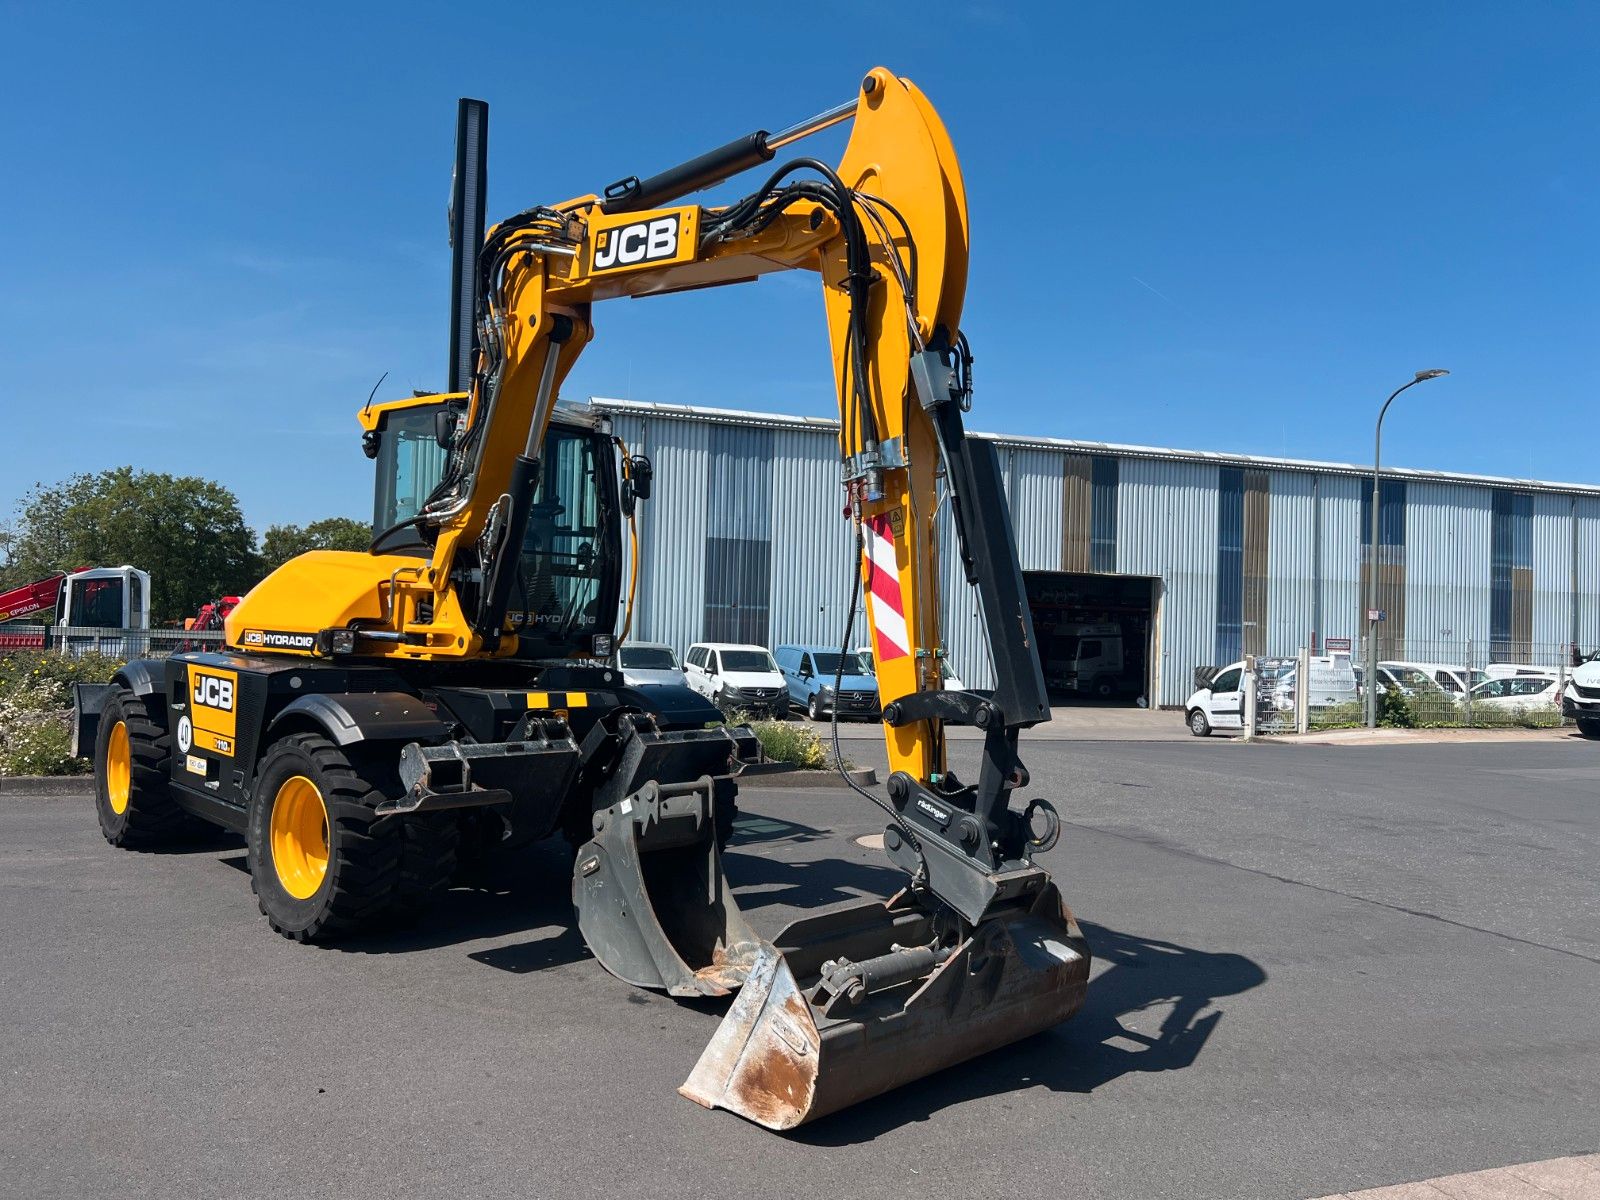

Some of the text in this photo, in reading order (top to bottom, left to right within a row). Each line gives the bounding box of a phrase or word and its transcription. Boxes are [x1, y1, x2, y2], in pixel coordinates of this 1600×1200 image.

[595, 218, 677, 267] JCB
[10, 603, 40, 616] EPSILON
[535, 614, 597, 624] HYDIG
[246, 633, 314, 647] JCB HYDRADIG
[194, 676, 233, 710] JCB
